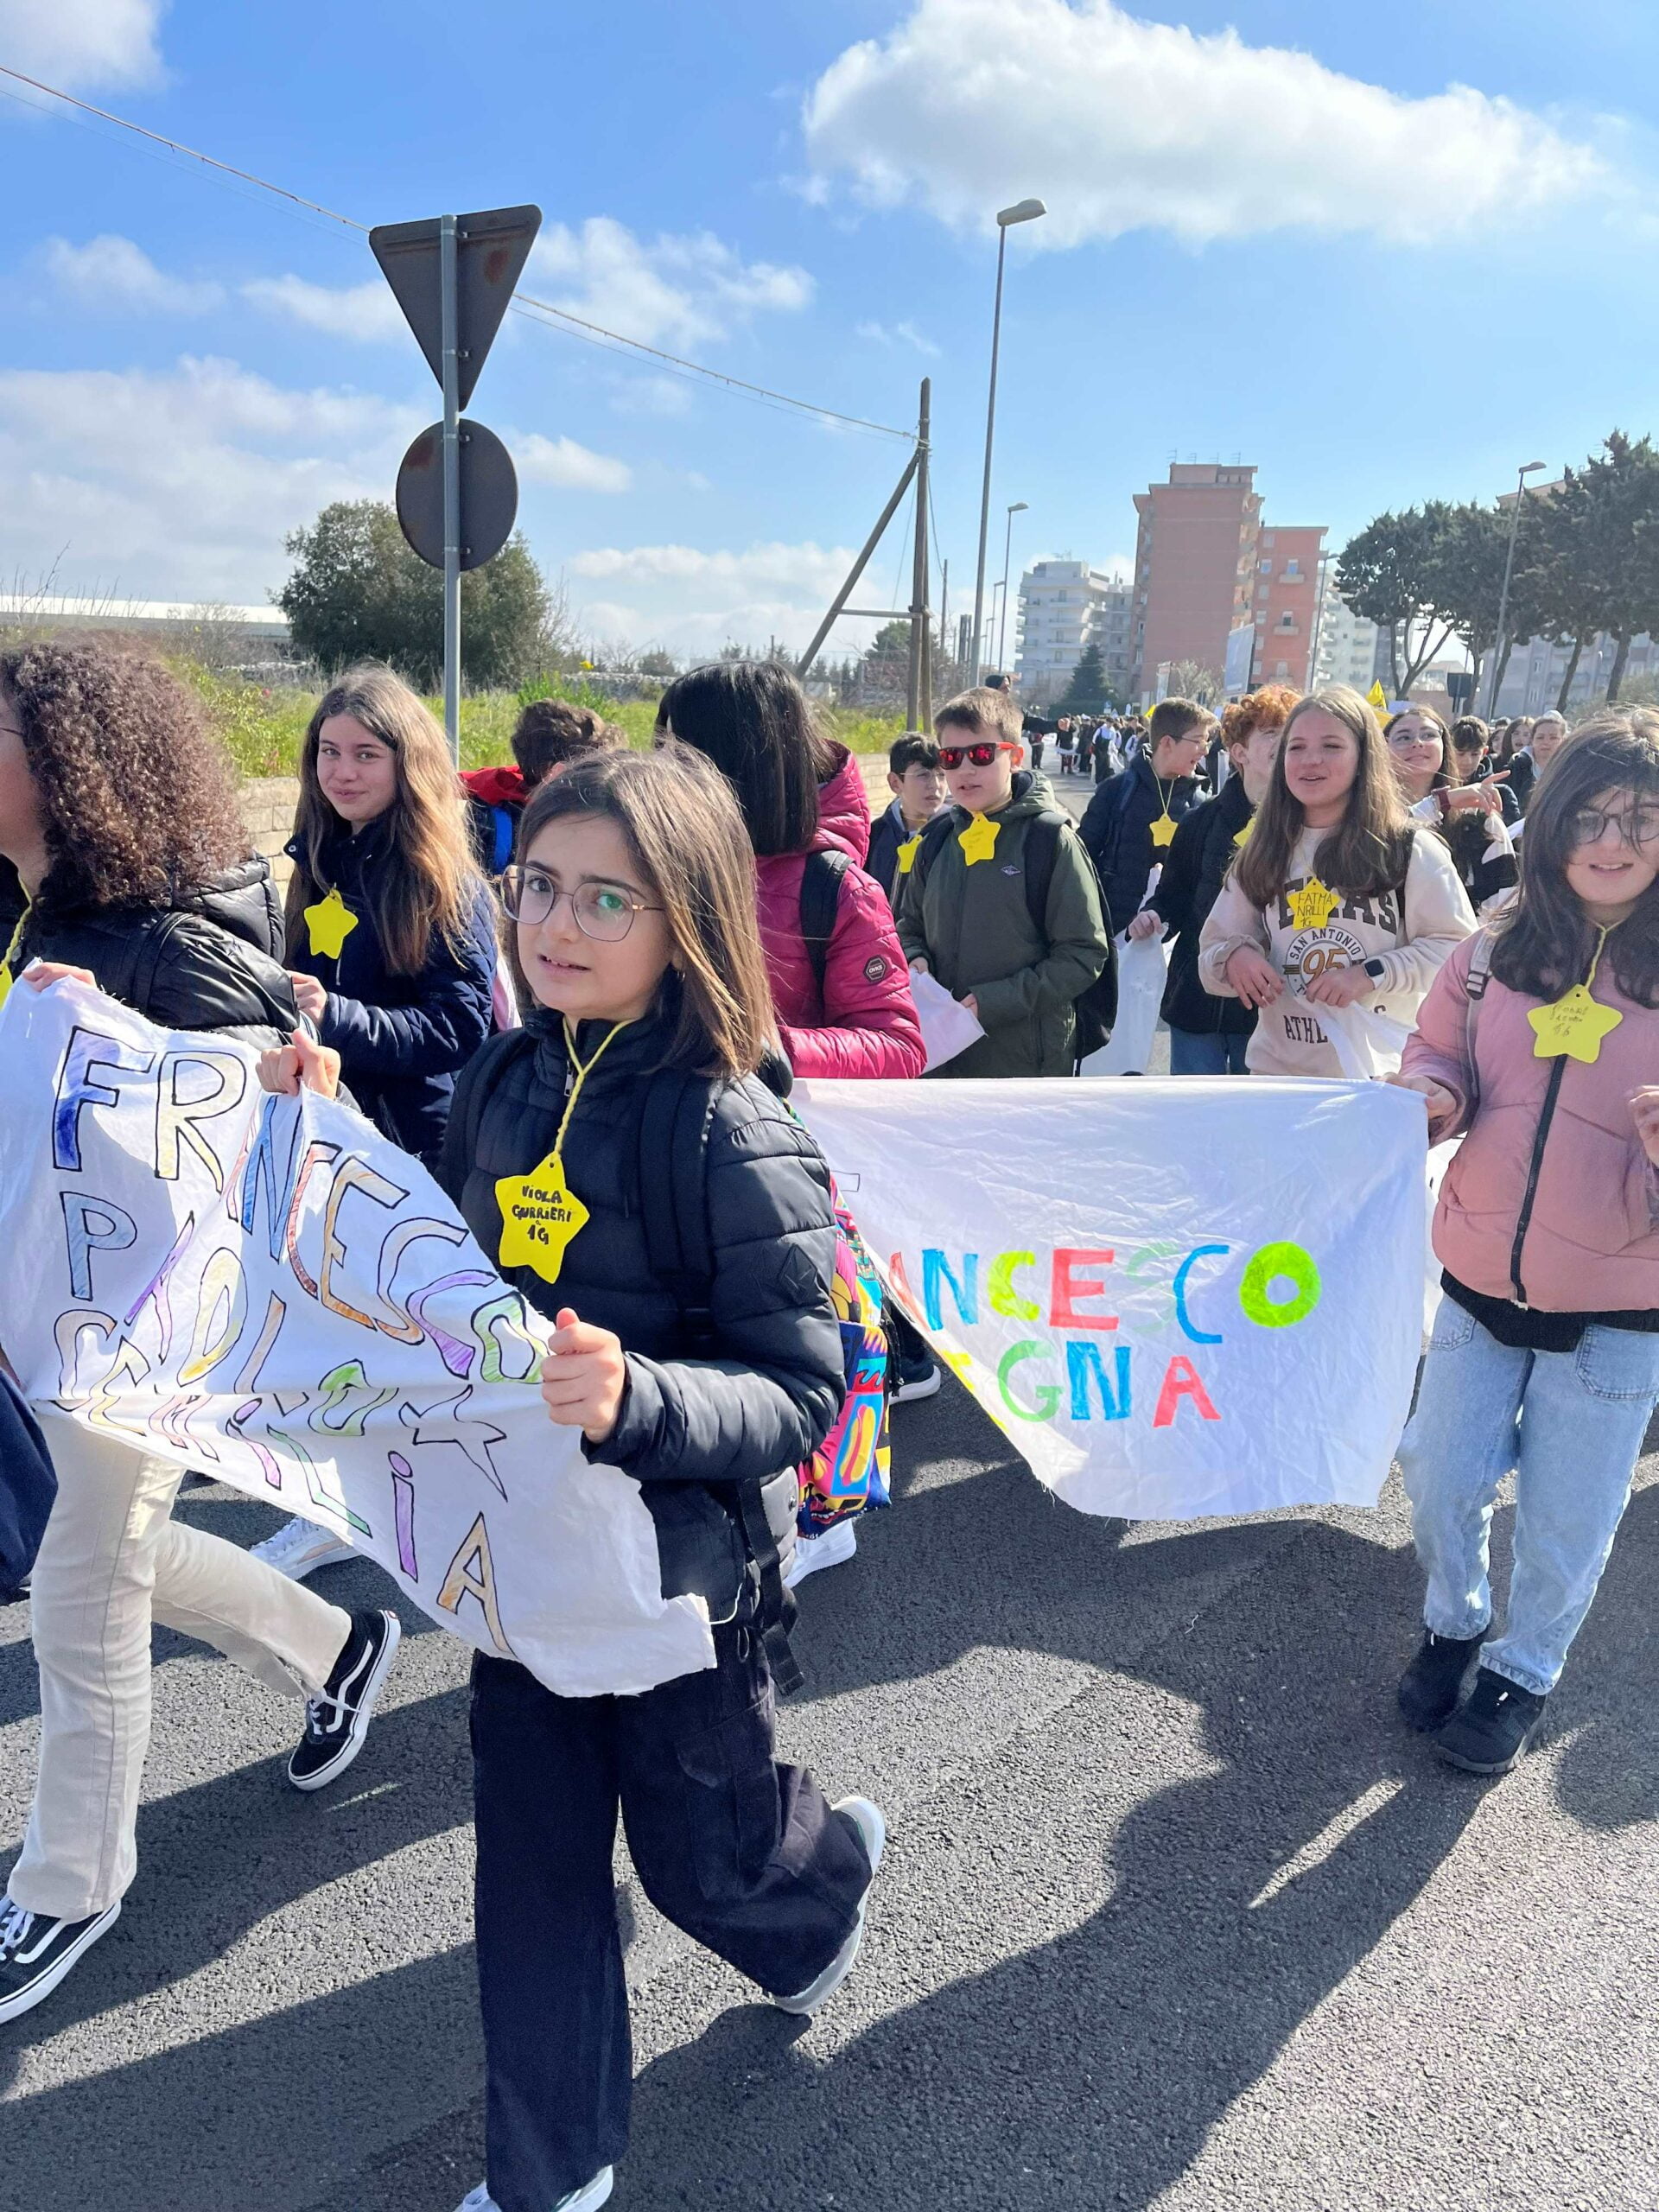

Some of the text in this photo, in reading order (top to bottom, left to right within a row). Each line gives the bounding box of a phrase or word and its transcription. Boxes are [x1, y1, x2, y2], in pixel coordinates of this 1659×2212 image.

[1298, 892, 1333, 906] FATMA
[1290, 928, 1362, 960] SAN ANTONIO
[1303, 948, 1348, 986] 95
